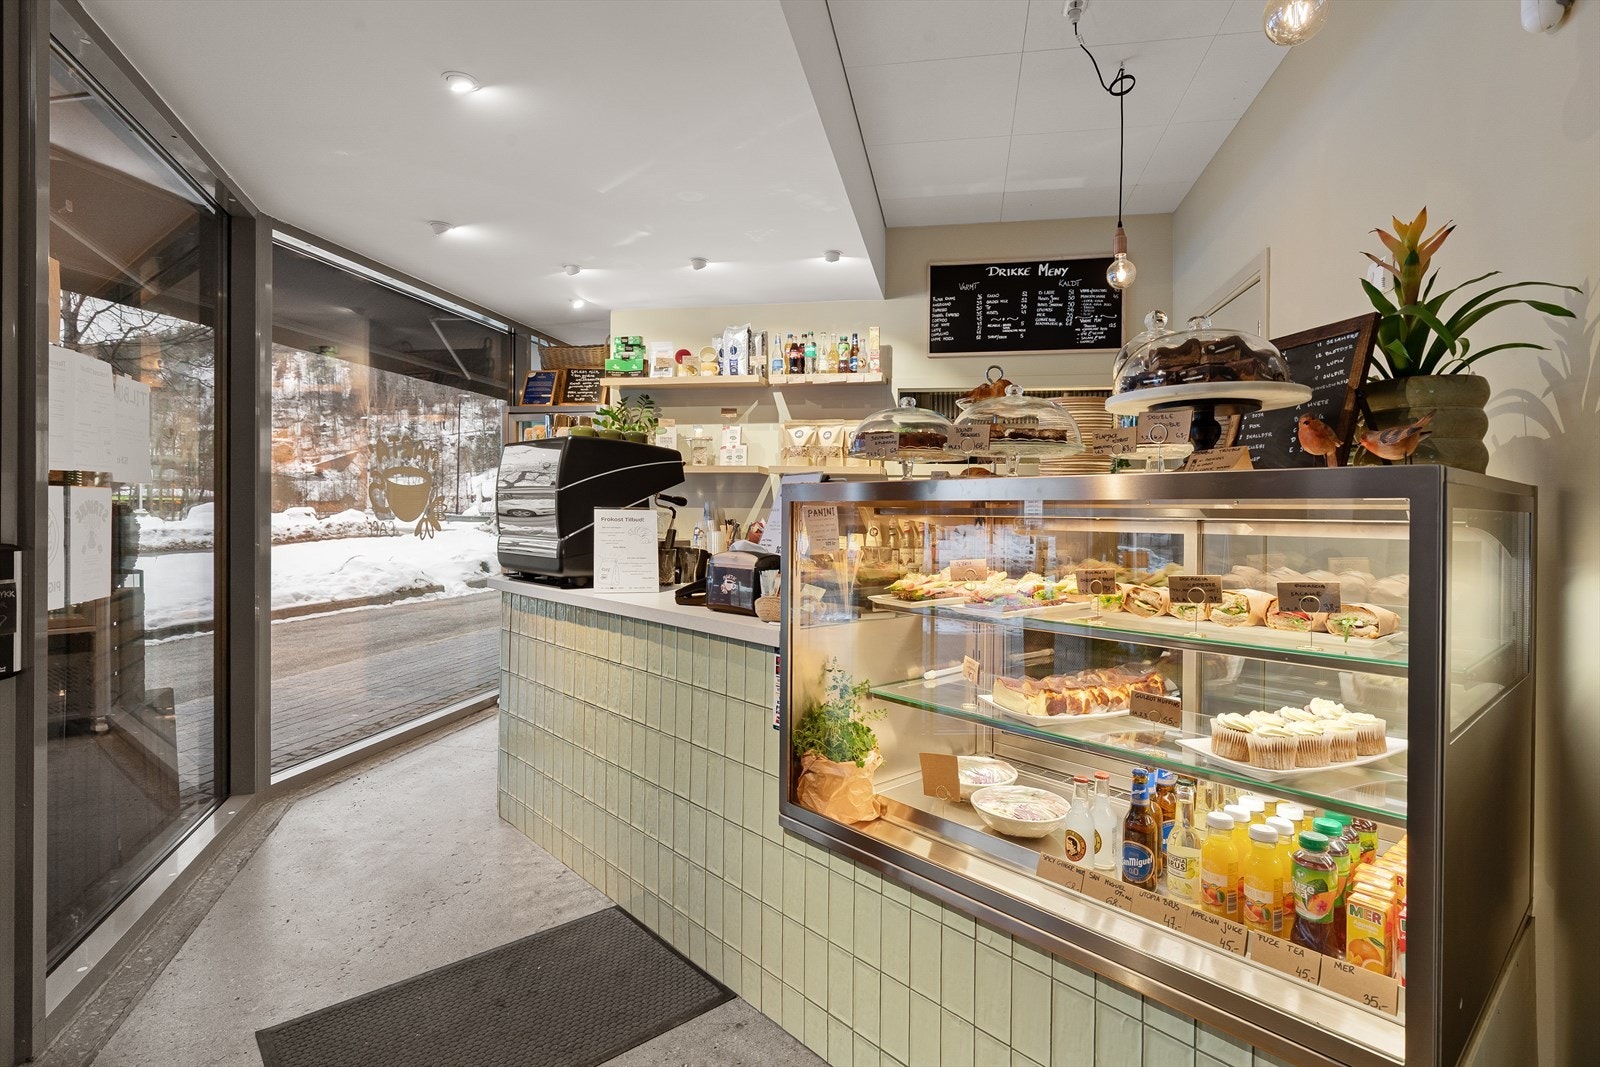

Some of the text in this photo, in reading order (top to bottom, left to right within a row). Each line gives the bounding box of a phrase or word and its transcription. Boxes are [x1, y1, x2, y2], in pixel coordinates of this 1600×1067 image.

[985, 263, 1068, 277] DRIKKE MENY
[959, 282, 980, 291] VARMT
[1058, 278, 1082, 288] KALDT
[1326, 356, 1346, 367] LUPIN
[1307, 398, 1329, 408] HVETE
[808, 507, 835, 517] PANINI
[1157, 698, 1180, 708] MUFFINS
[1042, 854, 1056, 864] SPICY
[1056, 860, 1074, 873] GINGER
[1088, 872, 1126, 892] SAN MIGUEL
[1139, 891, 1180, 911] UTOPIA BRUS
[1163, 914, 1182, 930] 47,-
[1191, 910, 1243, 935] APPELSIN JUICE
[1349, 904, 1382, 926] MER
[1220, 937, 1240, 953] 45,-
[1258, 934, 1305, 958] FUZE TEA
[1295, 966, 1316, 982] 45,-
[1334, 962, 1354, 974] MER
[1363, 994, 1388, 1011] 35,-
